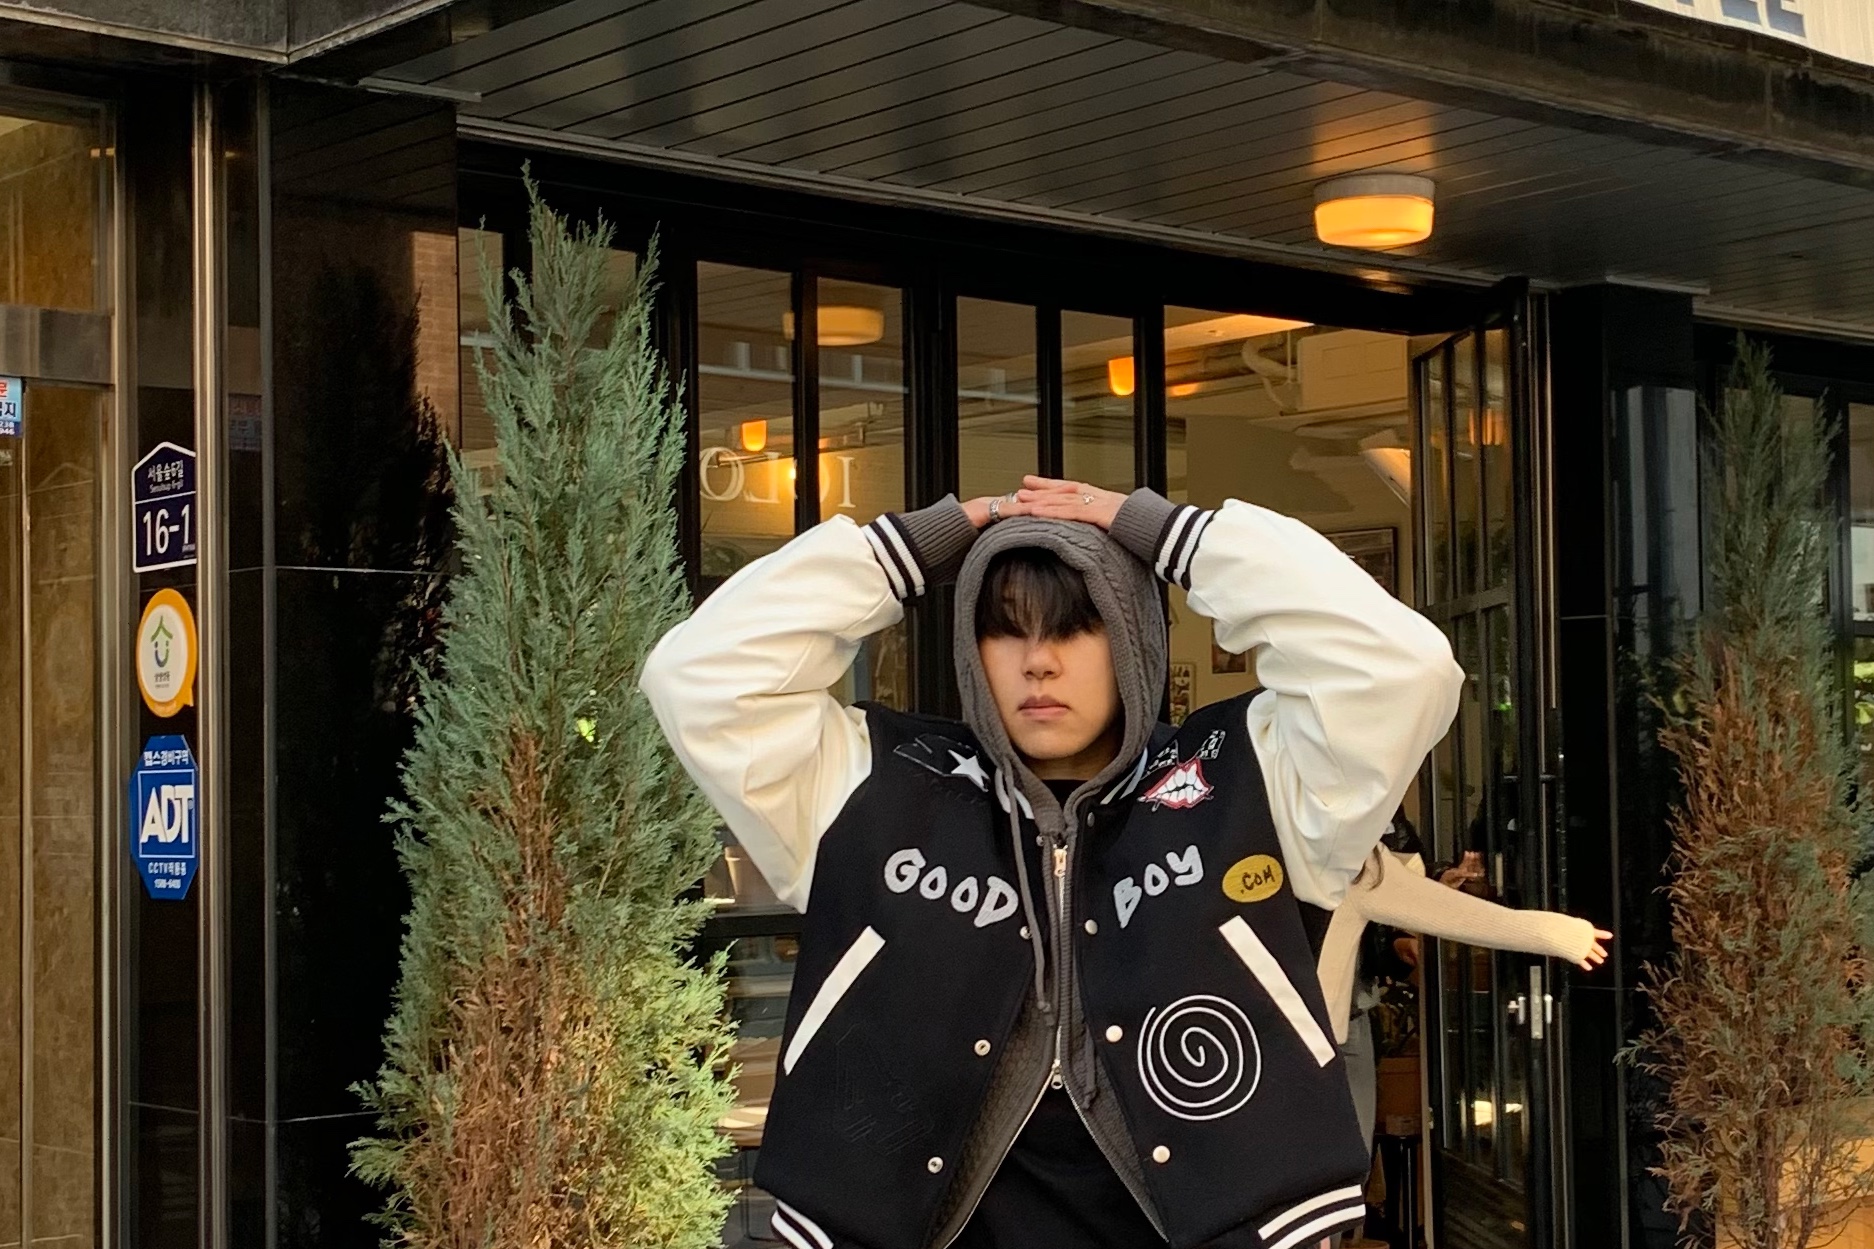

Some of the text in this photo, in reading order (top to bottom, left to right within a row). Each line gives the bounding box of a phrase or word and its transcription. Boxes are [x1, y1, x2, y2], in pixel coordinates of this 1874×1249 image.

[142, 503, 190, 556] 16-1
[140, 784, 194, 844] ADT
[884, 844, 1204, 929] GOOD BOY
